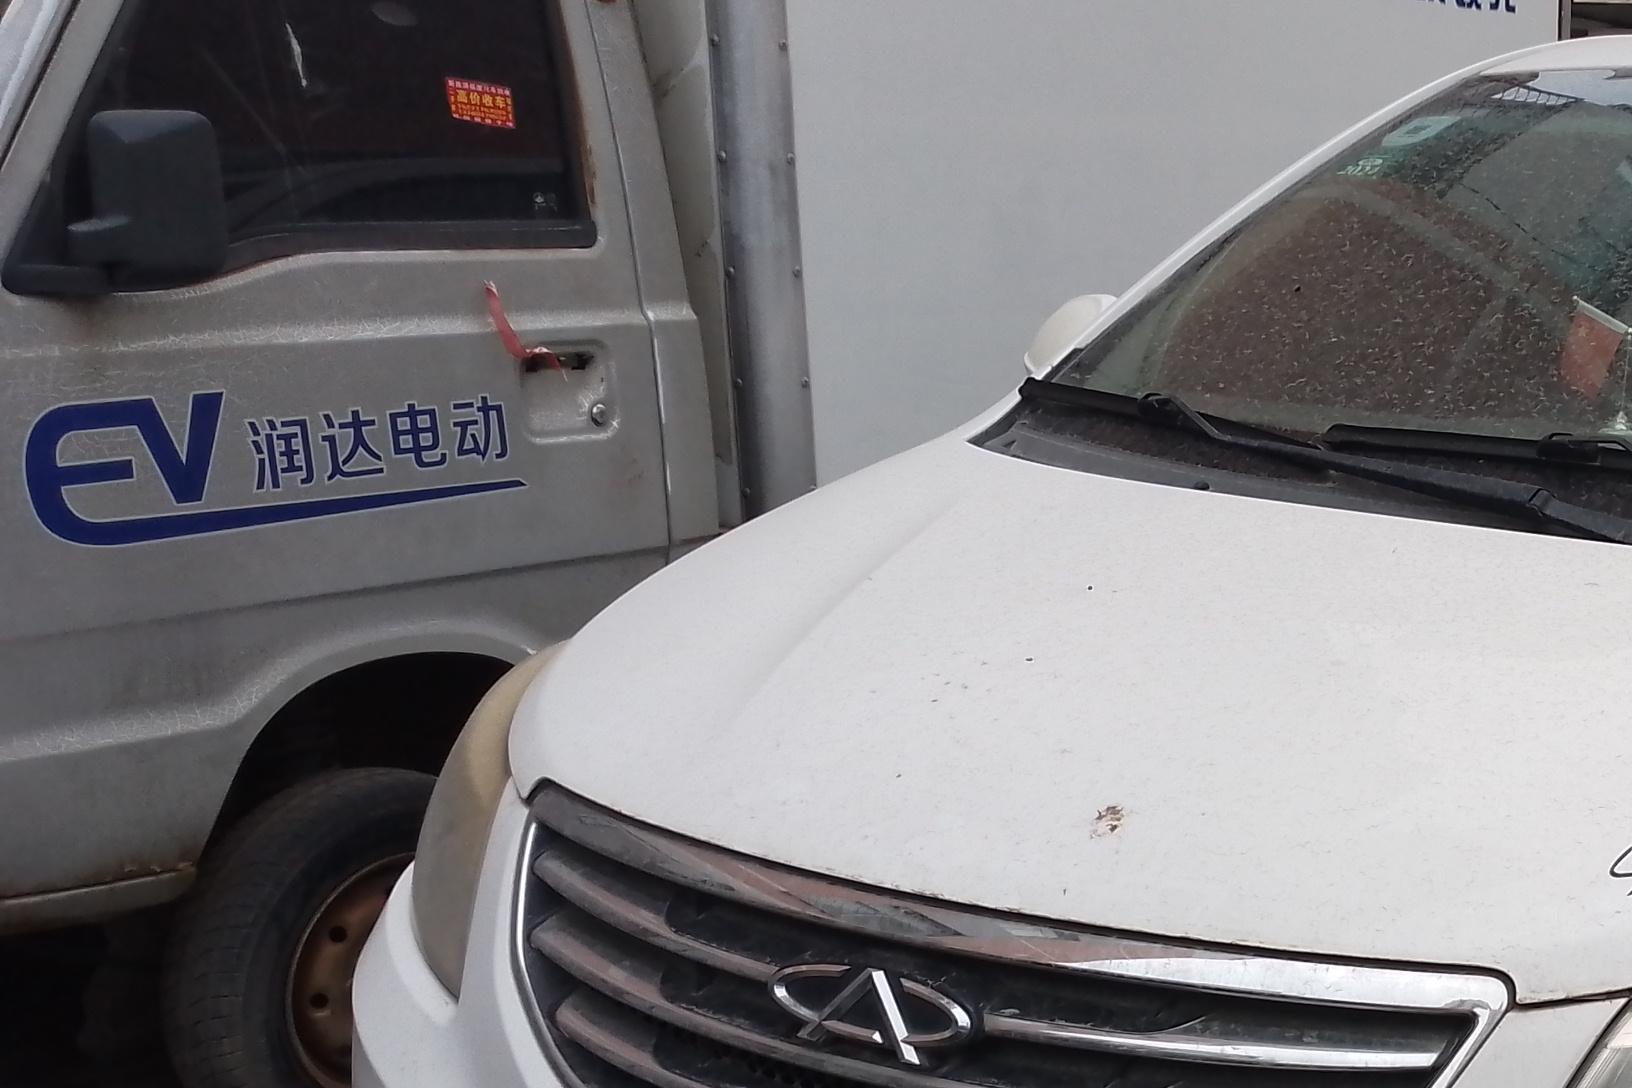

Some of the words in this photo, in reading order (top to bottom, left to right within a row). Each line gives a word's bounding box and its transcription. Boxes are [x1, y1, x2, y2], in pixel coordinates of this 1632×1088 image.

[456, 89, 507, 109] 高价收车
[25, 391, 224, 545] EV
[245, 395, 509, 491] 润达电动
